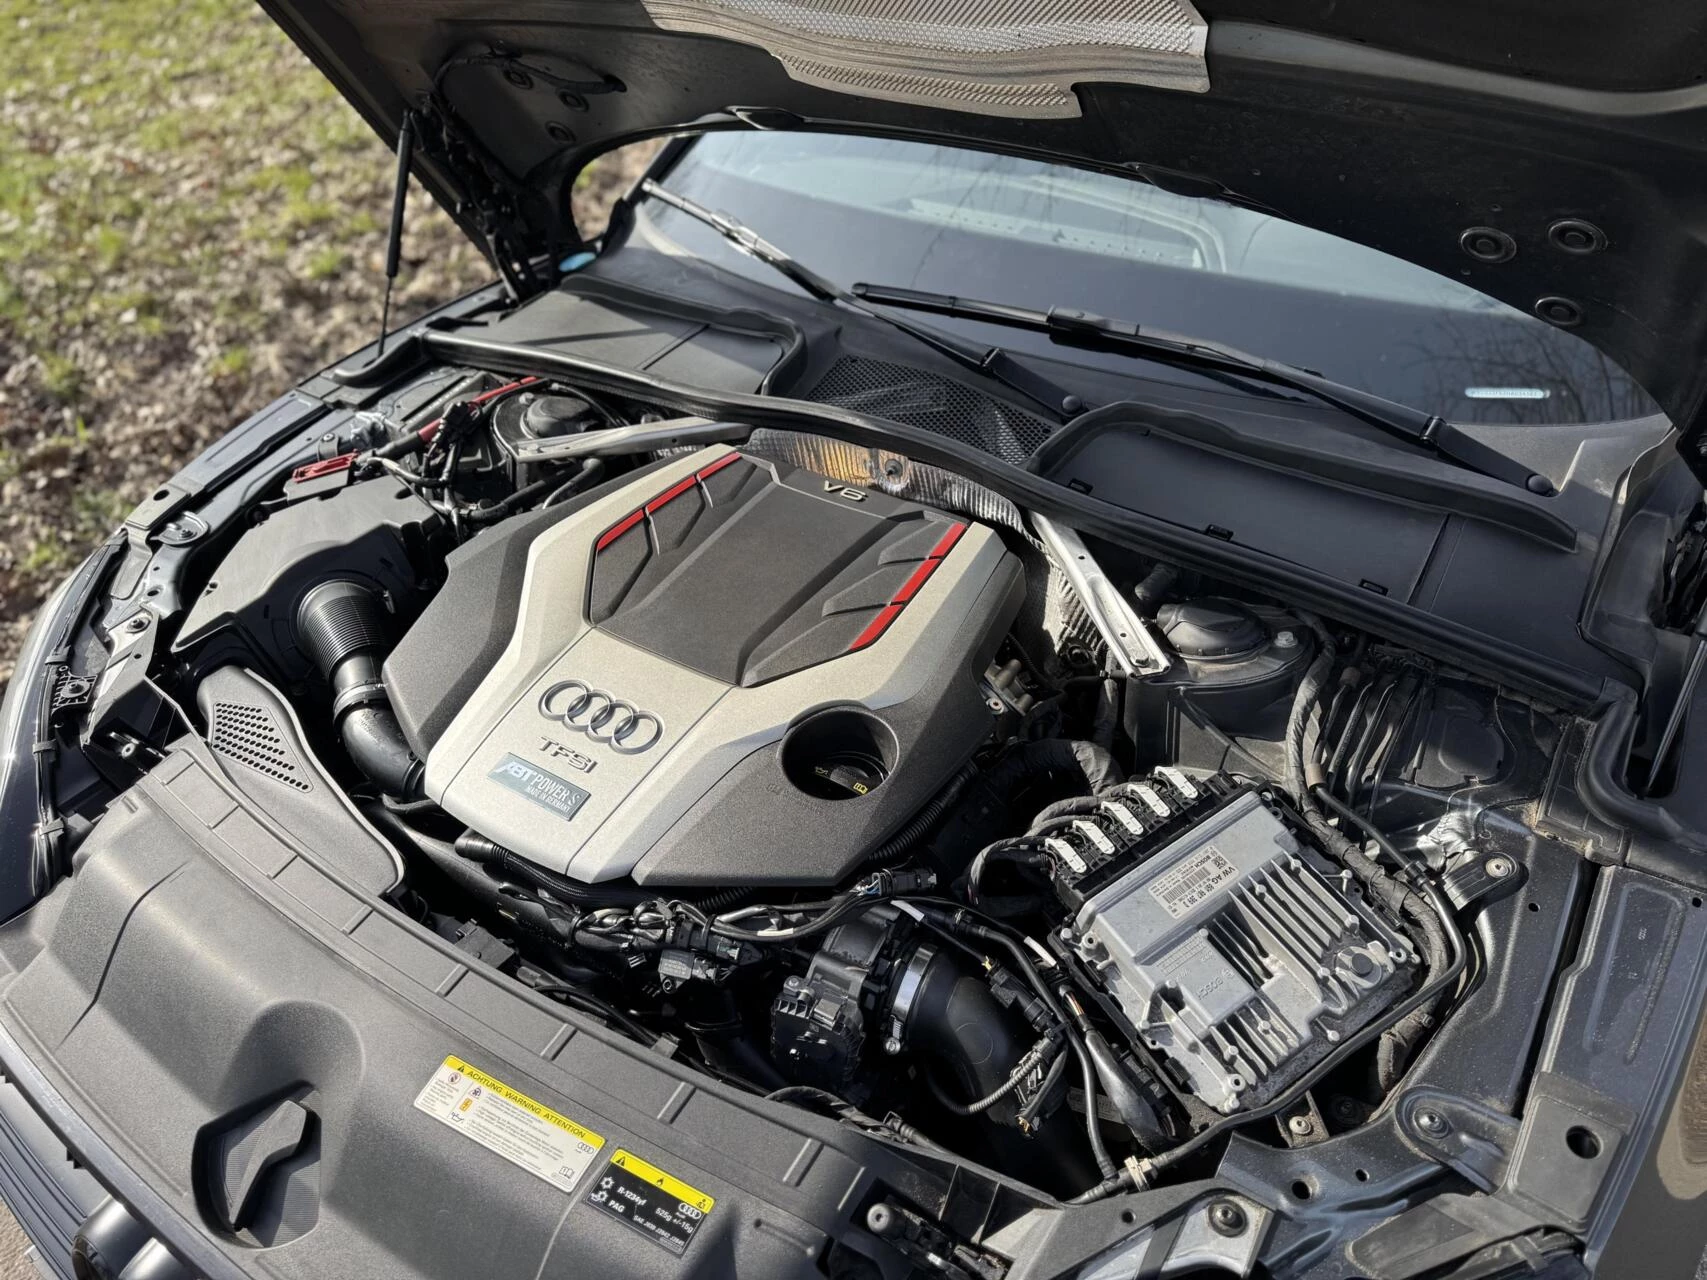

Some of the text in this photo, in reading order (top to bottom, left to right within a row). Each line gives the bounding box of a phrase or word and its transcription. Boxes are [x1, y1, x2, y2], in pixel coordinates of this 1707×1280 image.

[824, 480, 866, 501] V6
[538, 736, 598, 774] TFSI
[495, 761, 537, 781] ABT
[531, 774, 570, 802] POWER
[546, 794, 571, 812] GERMANY
[1211, 874, 1222, 884] AG
[1222, 866, 1236, 877] VW
[466, 1070, 503, 1094] ACHTUNG
[504, 1089, 541, 1115] WARNING
[543, 1112, 586, 1138] ATTENTION
[607, 1200, 625, 1212] PAG
[616, 1186, 647, 1206] R-1234yf
[655, 1207, 672, 1221] 525g
